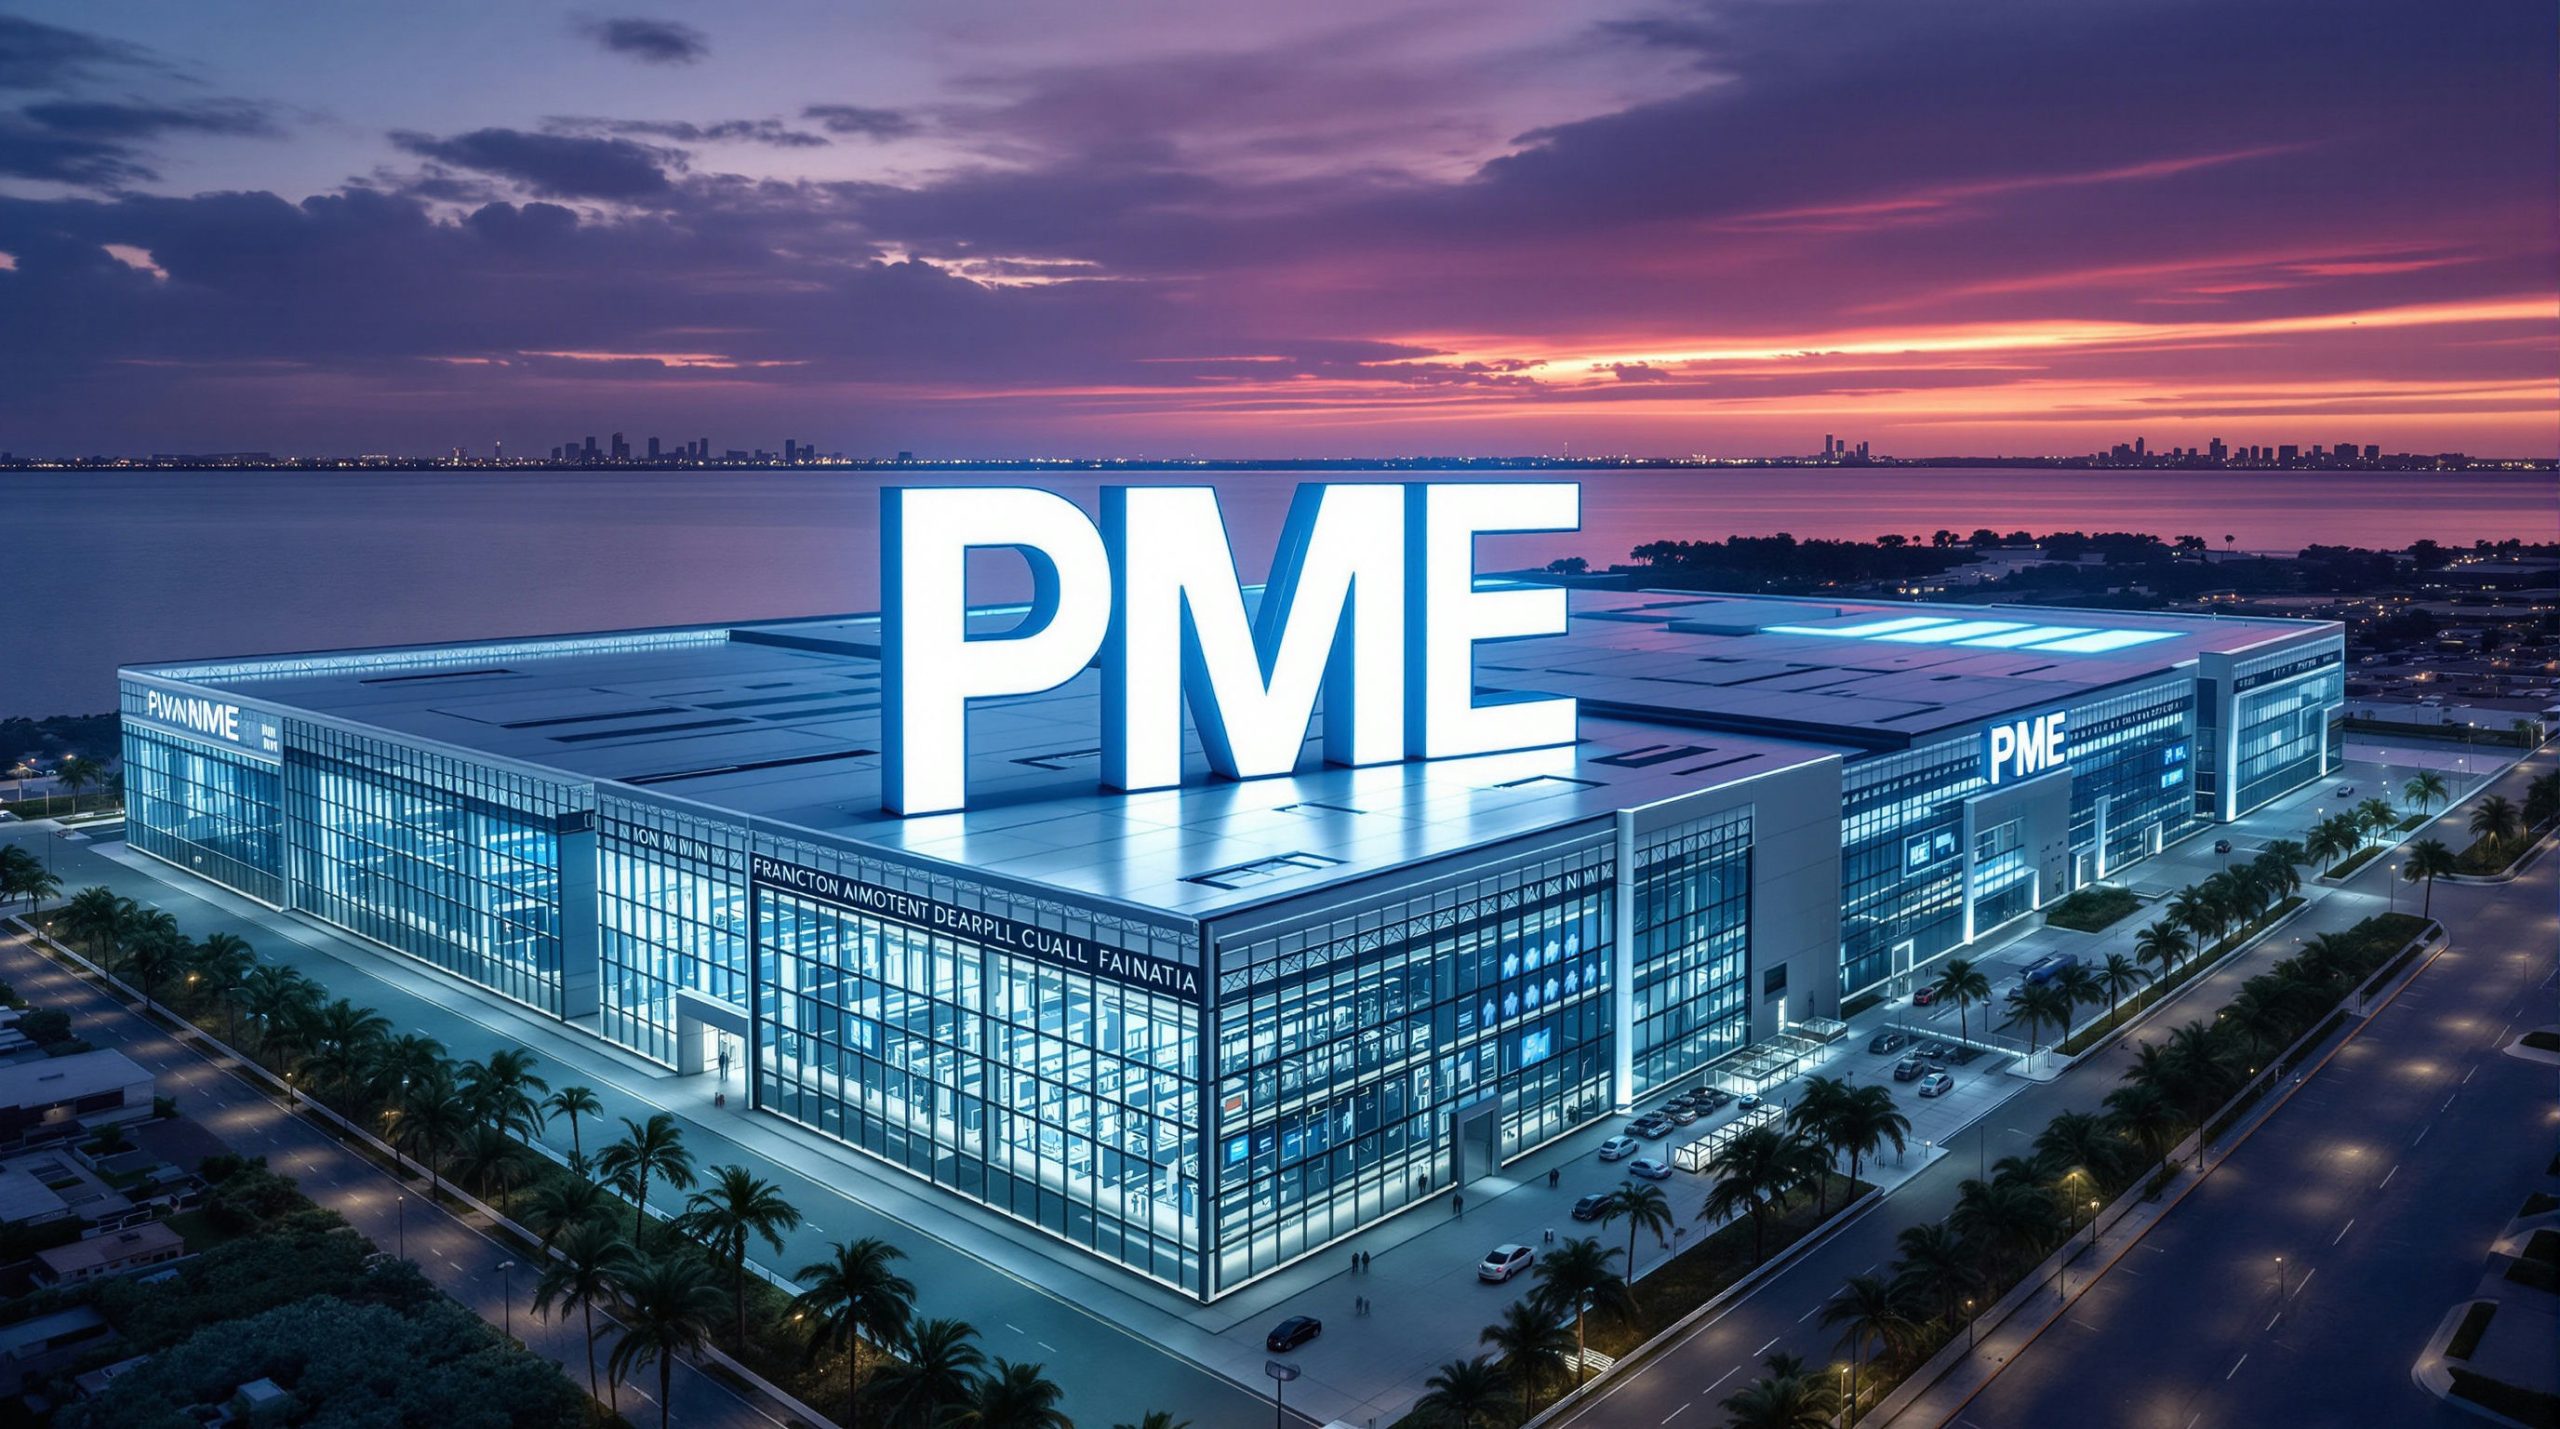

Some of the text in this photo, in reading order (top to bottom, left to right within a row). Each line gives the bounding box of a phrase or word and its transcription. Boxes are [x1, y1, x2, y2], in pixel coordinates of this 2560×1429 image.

[881, 483, 1581, 817] PME
[1990, 711, 2066, 785] PME
[753, 857, 839, 896] FRANCTON
[934, 904, 1016, 945] DEARPLL
[1021, 928, 1088, 964] CUALL
[1099, 949, 1197, 995] FAINATIA
